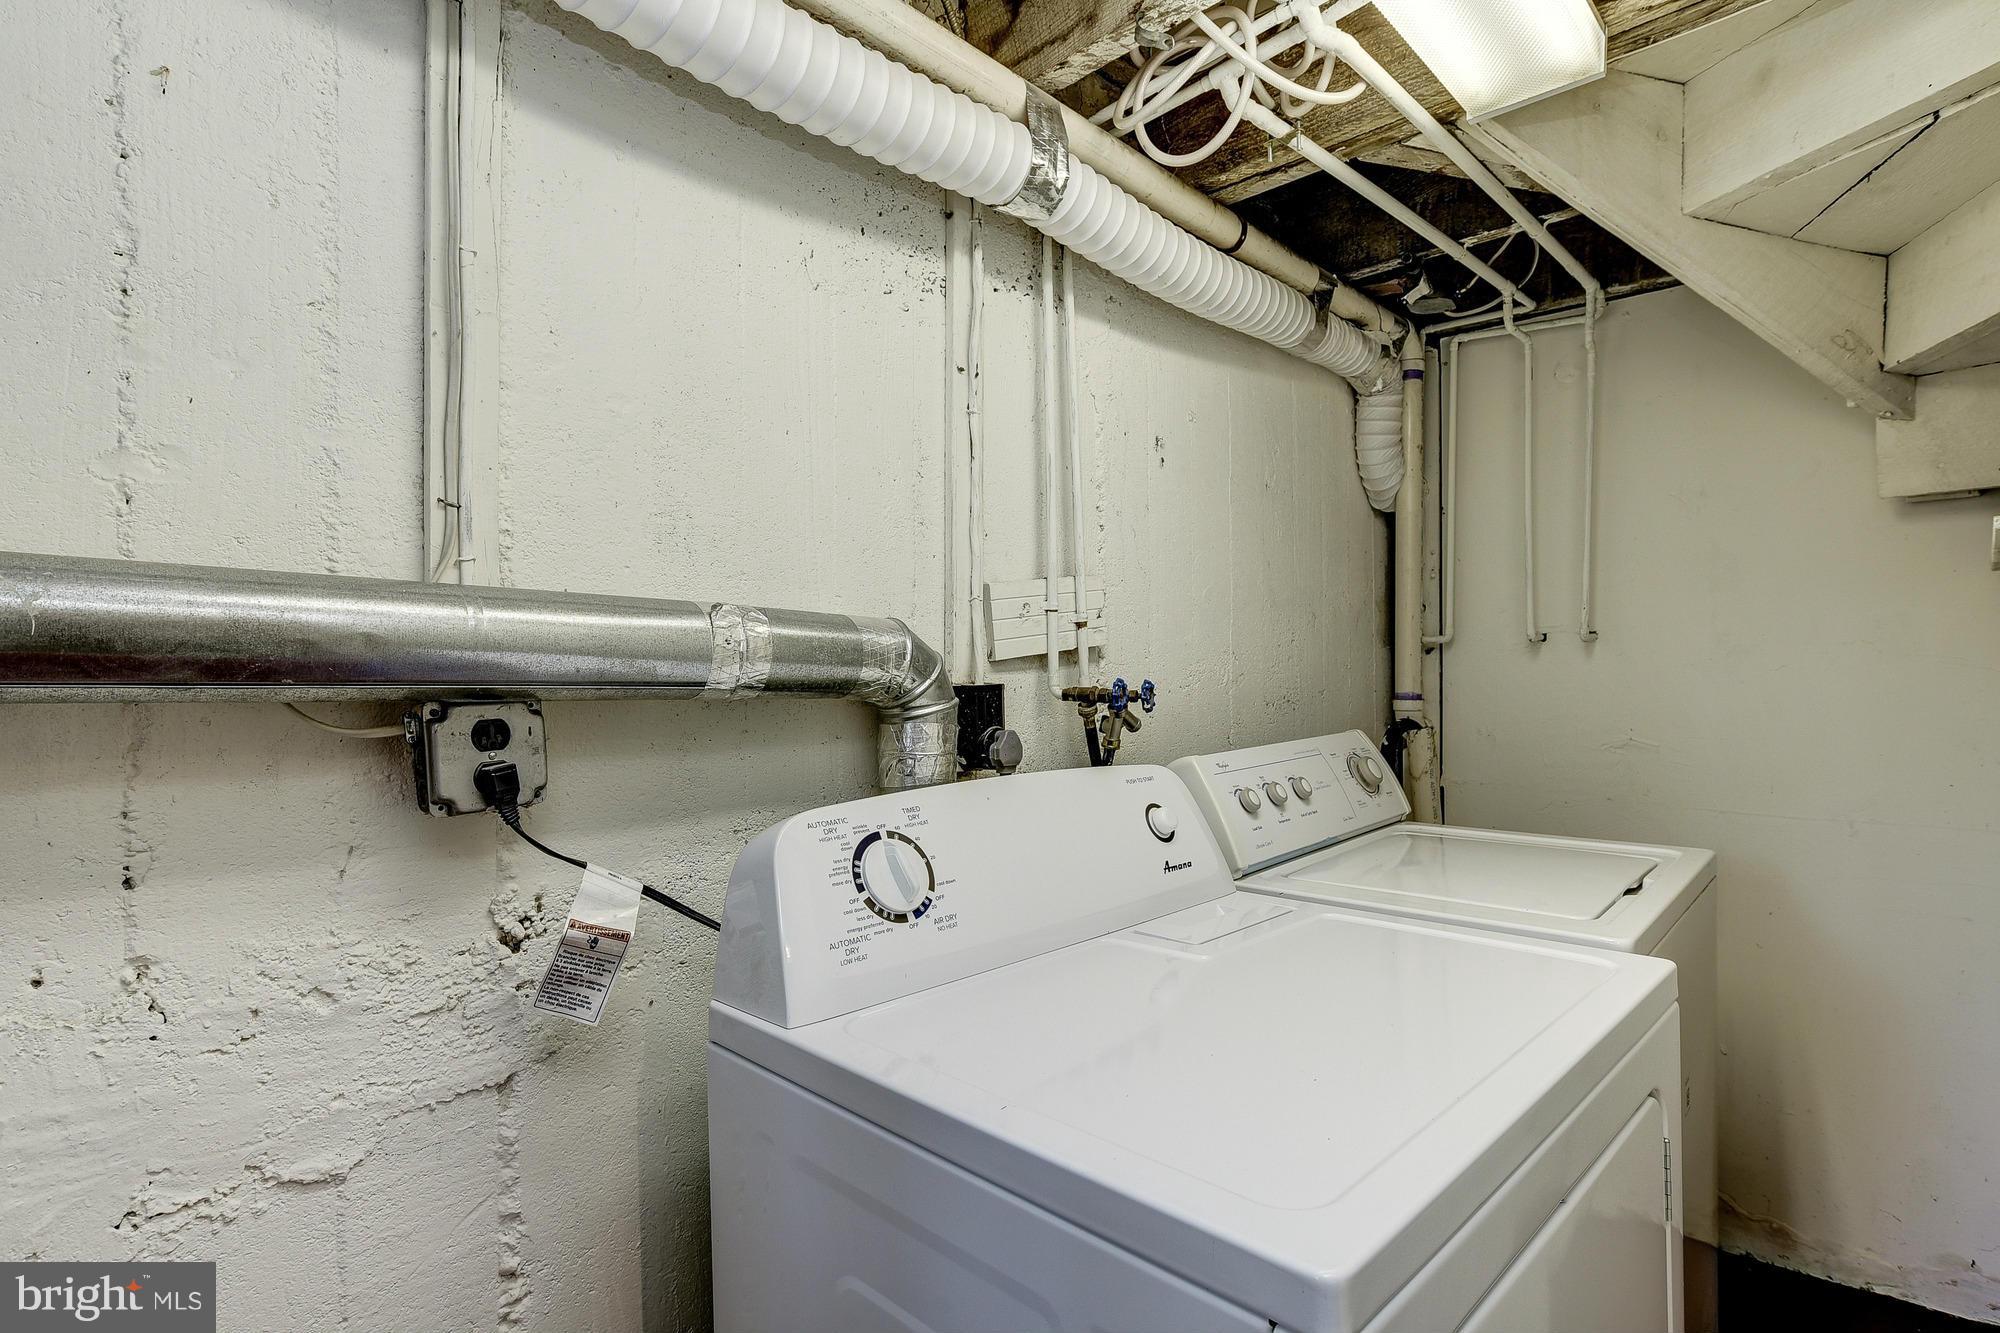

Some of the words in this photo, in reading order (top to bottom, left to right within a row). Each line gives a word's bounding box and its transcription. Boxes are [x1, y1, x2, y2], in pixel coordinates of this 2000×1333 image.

[902, 806, 920, 814] TIMED
[807, 818, 848, 829] AUTOMATIC
[823, 827, 837, 835] DRY
[1163, 860, 1192, 874] Amana
[934, 917, 944, 925] AIR
[945, 913, 957, 922] DRY
[576, 923, 629, 940] AVERTISSEMENT
[830, 934, 871, 951] AUTOMATIC
[845, 946, 860, 956] DRY
[840, 958, 853, 966] LOW
[854, 954, 868, 962] HEAT
